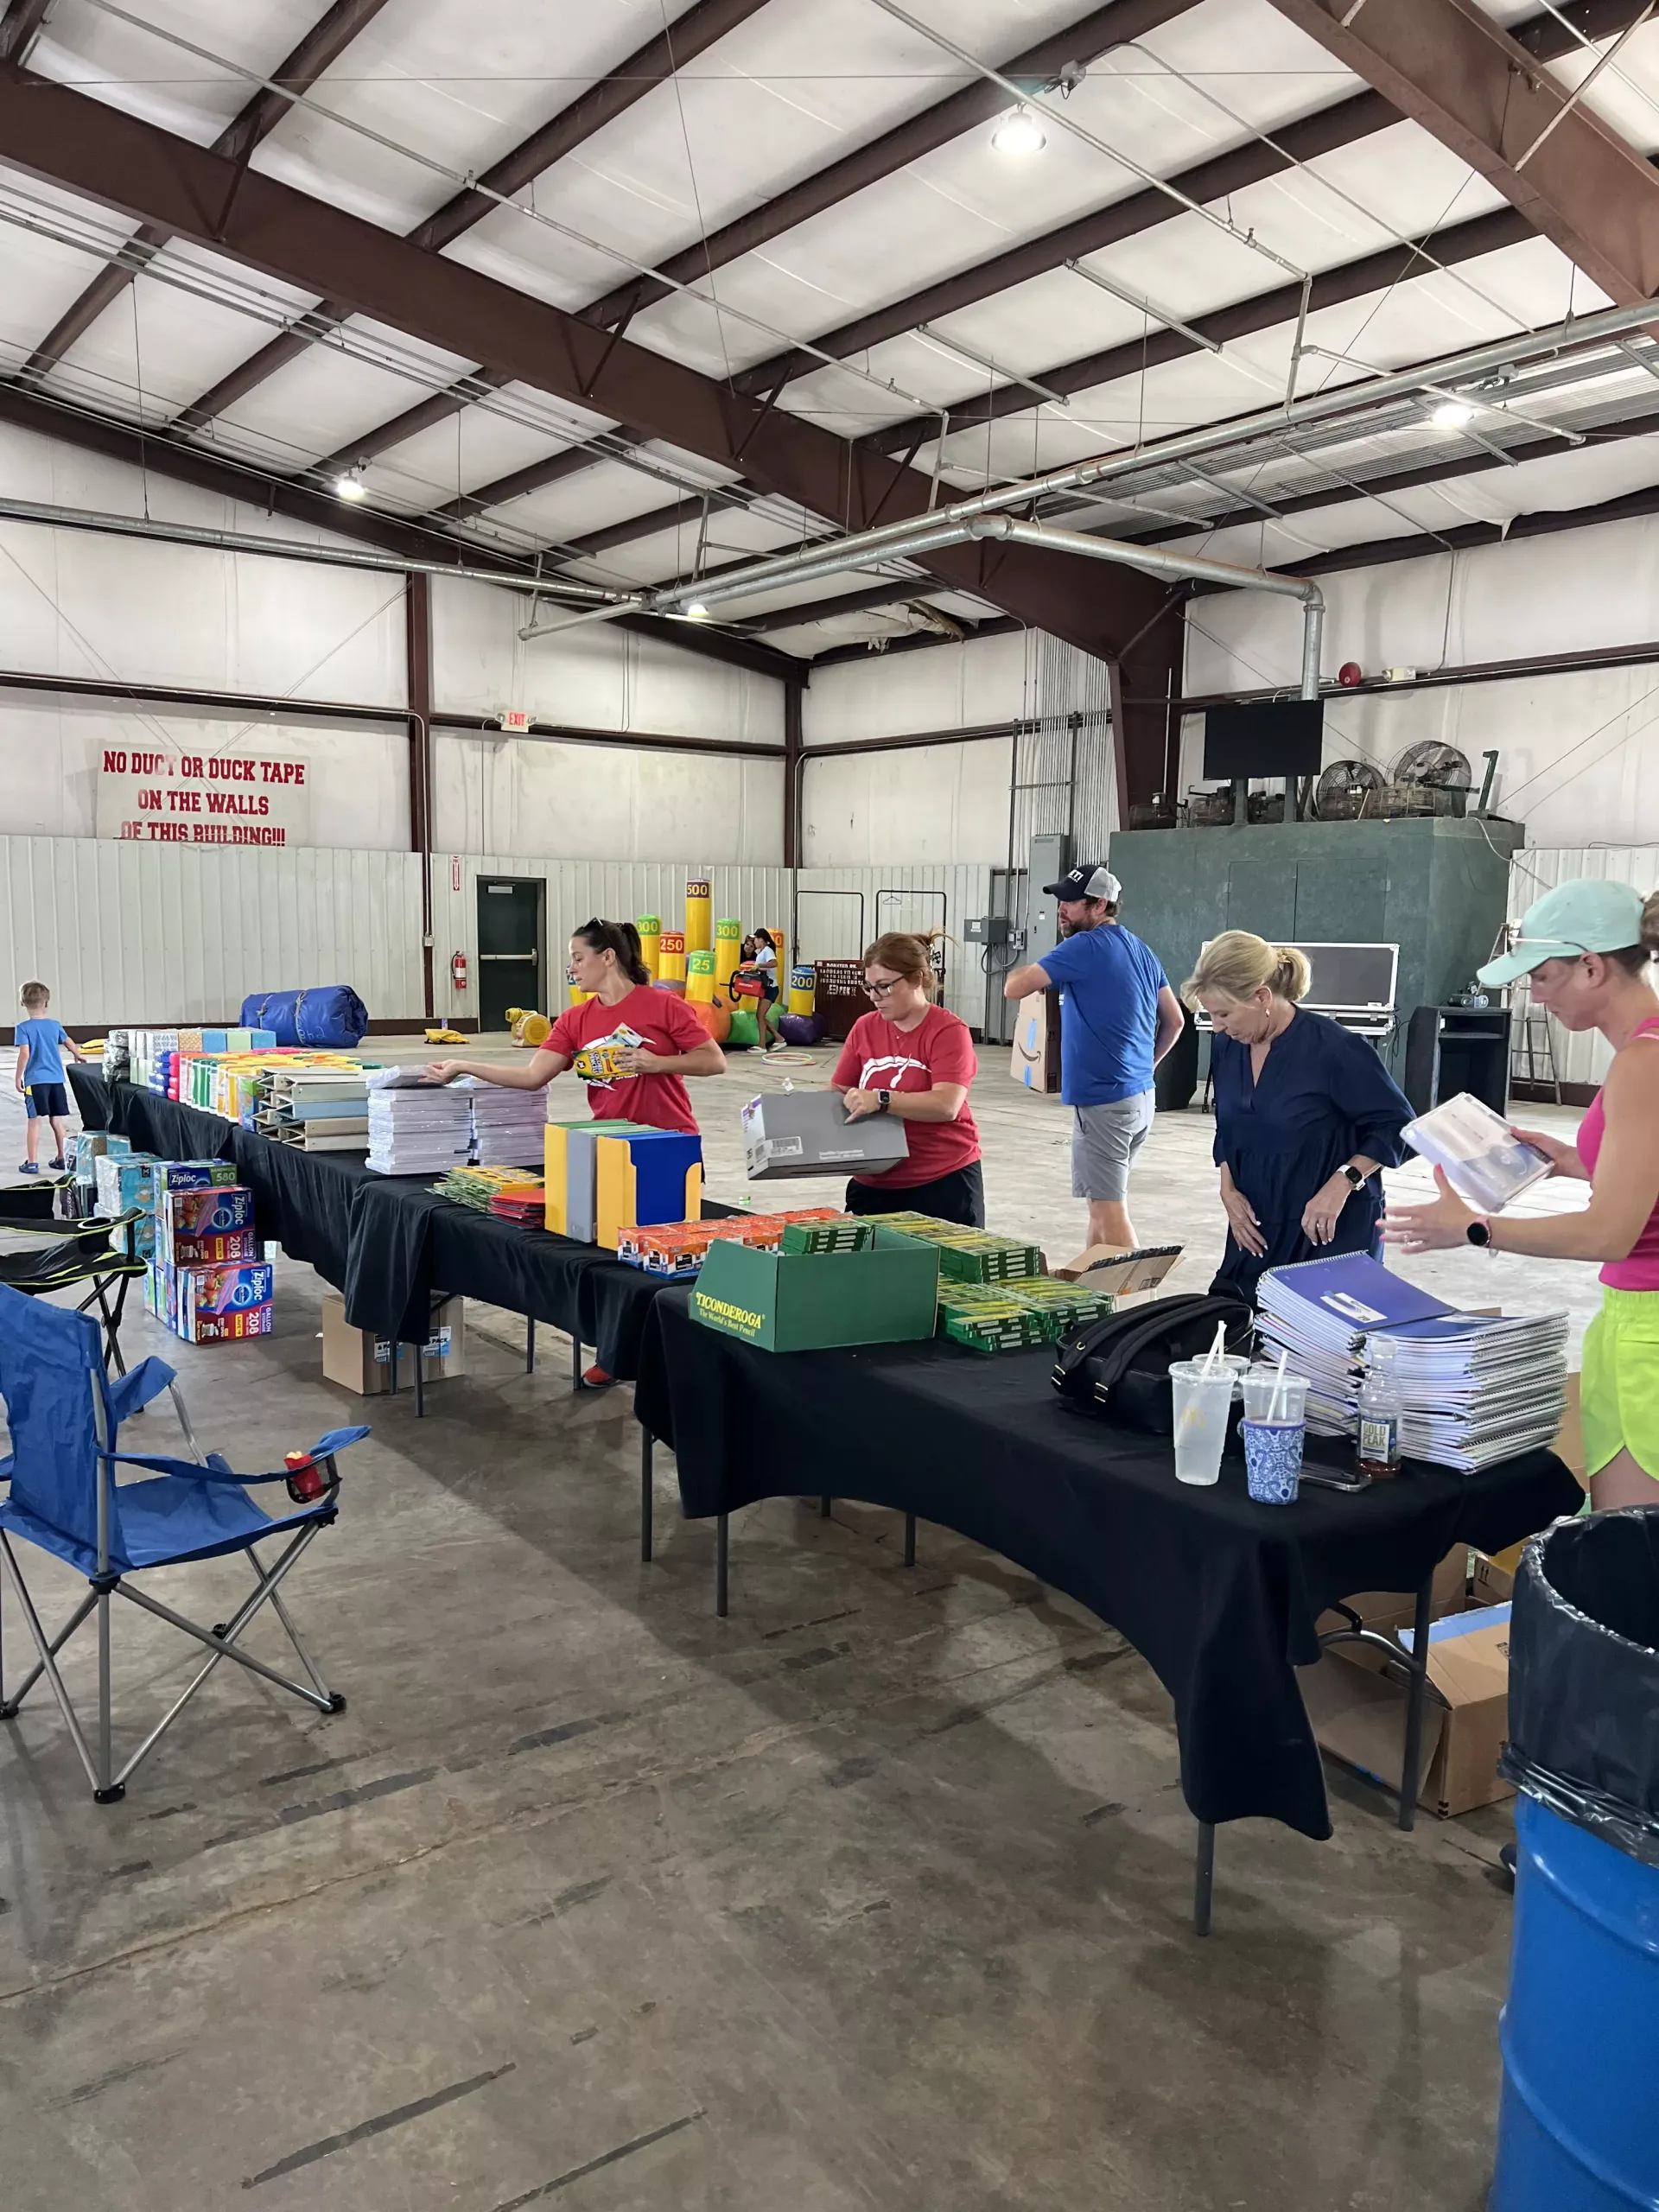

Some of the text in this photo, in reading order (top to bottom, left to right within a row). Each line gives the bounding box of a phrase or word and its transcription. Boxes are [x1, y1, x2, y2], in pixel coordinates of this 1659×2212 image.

[509, 712, 525, 726] EXIT
[104, 751, 305, 785] NO DUCT OR DUCK TAPE
[138, 789, 269, 815] ON THE WALLS
[121, 821, 285, 847] OF THIS BUILDING!!!
[686, 884, 707, 895] 500
[637, 921, 658, 932] 300
[716, 925, 738, 937] 300
[660, 939, 683, 951] 250
[693, 958, 709, 970] 25
[792, 976, 812, 988] 200
[171, 1173, 196, 1185] Ziploc
[216, 1173, 235, 1182] 580
[232, 1197, 245, 1225] Ziploc
[230, 1236, 241, 1259] 208
[251, 1272, 264, 1300] Ziploc
[696, 1292, 761, 1329] TICONDEROGA
[249, 1312, 259, 1334] 208
[699, 1308, 708, 1318] The
[709, 1312, 728, 1325] World's
[728, 1319, 739, 1331] Best
[1363, 1422, 1386, 1436] GOLD
[1362, 1433, 1386, 1446] PEAK
